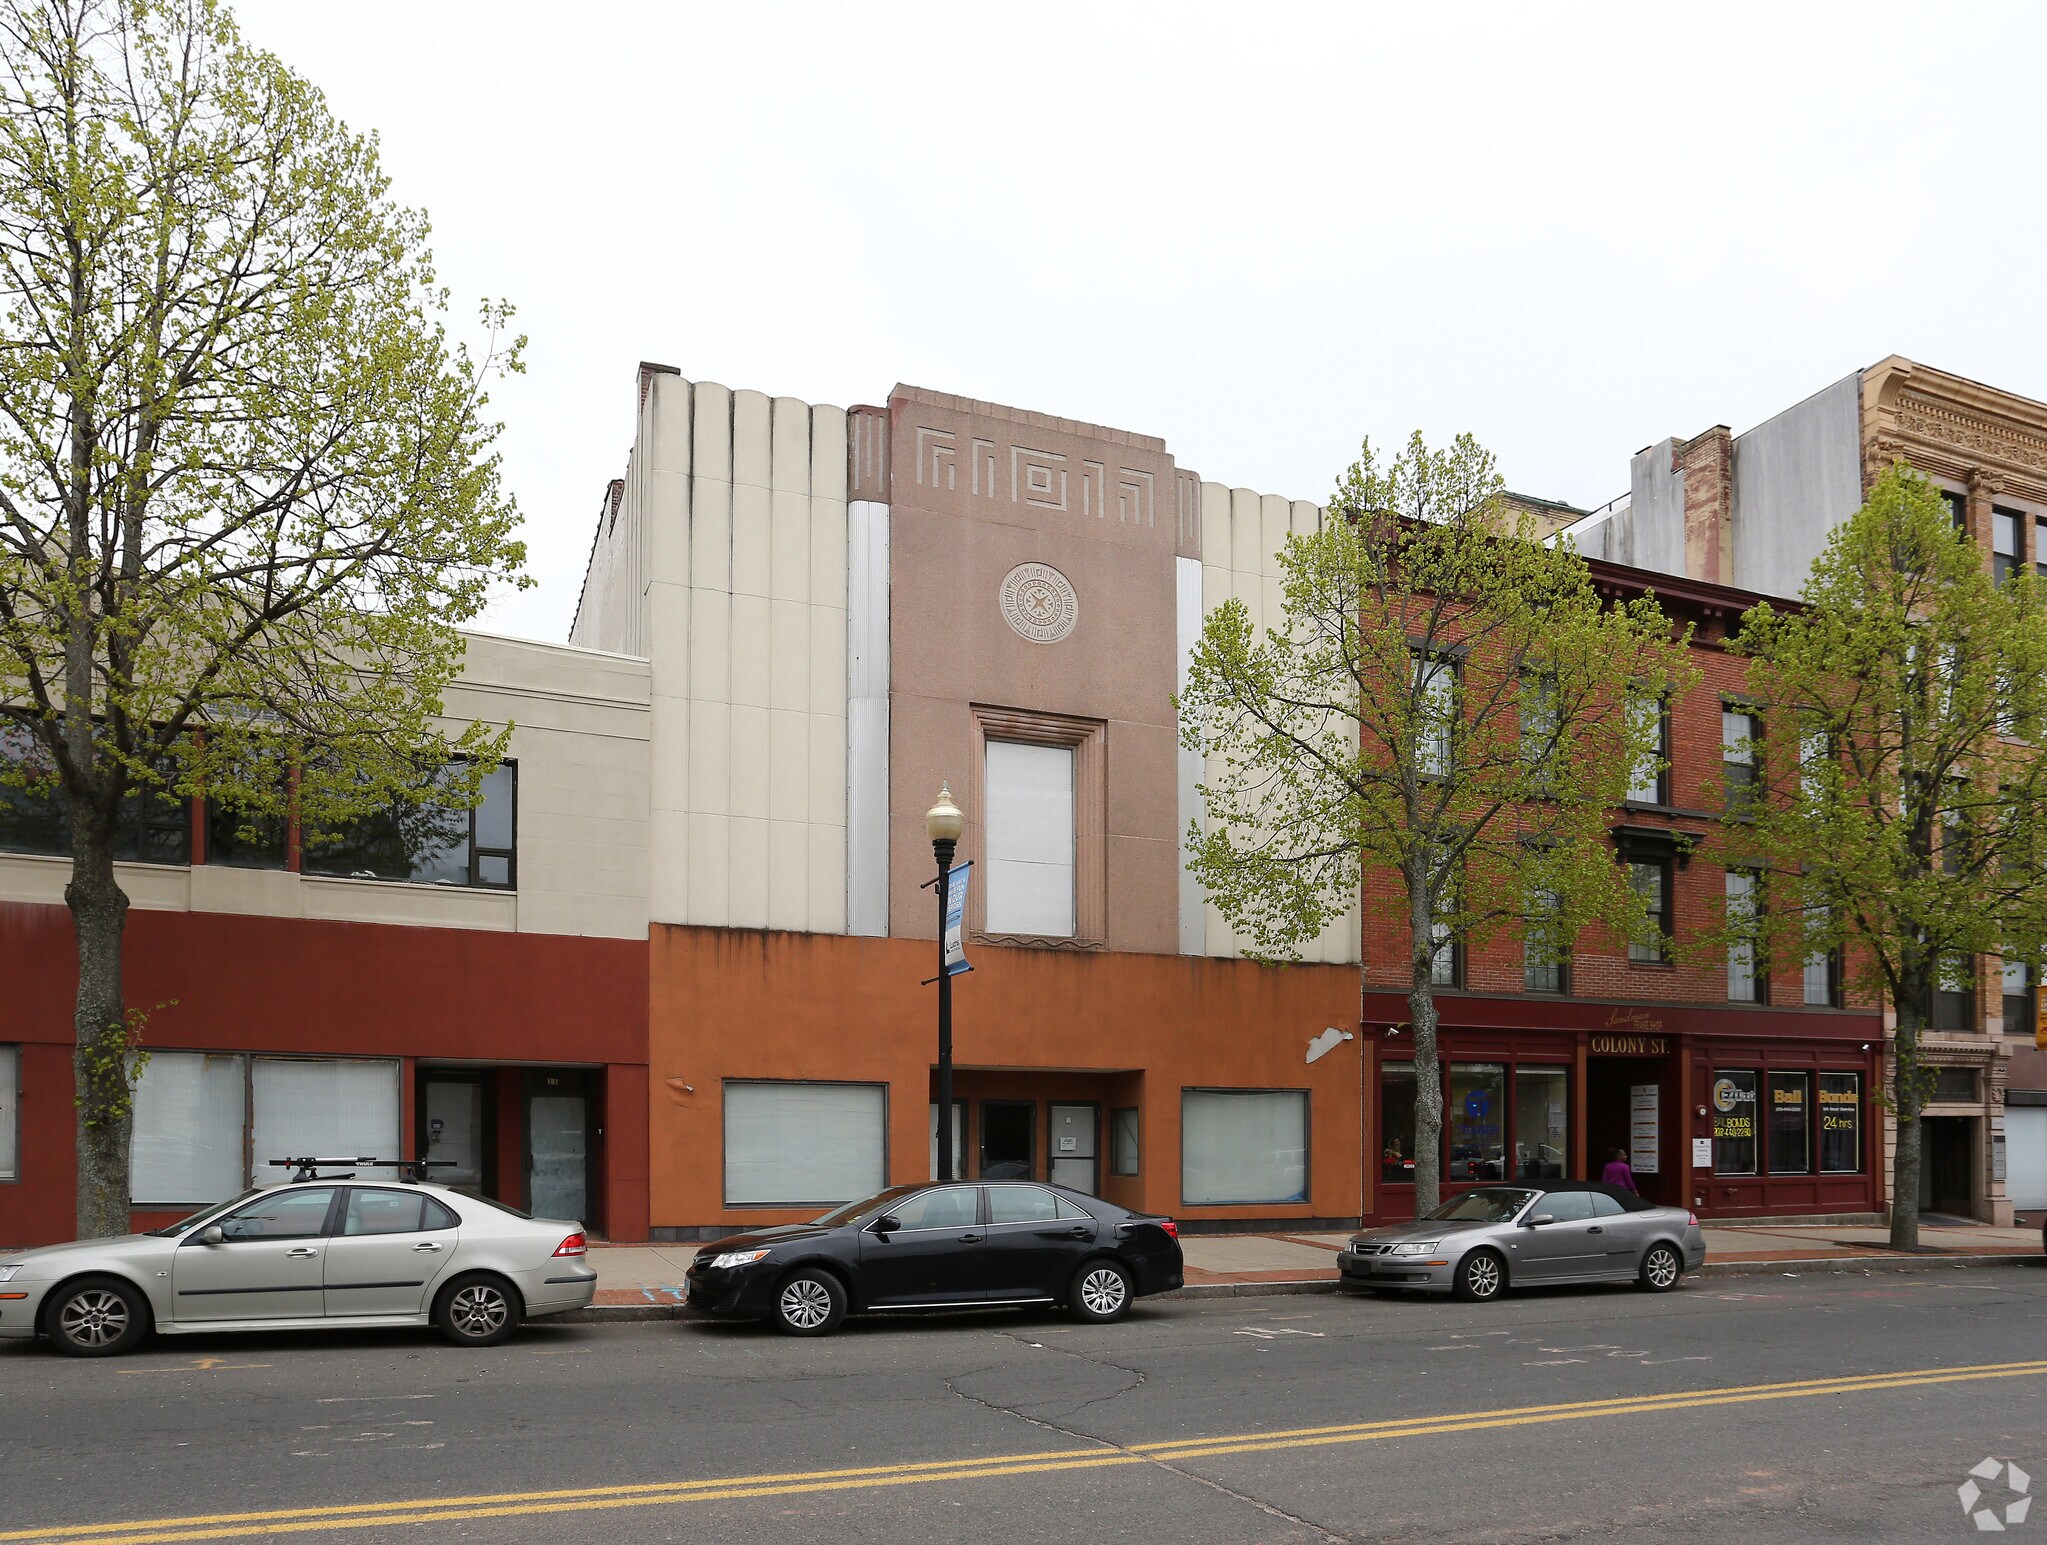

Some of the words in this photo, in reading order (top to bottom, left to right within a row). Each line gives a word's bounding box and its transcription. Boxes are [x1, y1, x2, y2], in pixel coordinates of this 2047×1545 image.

[1605, 1008, 1650, 1027] Sandman
[1592, 1036, 1646, 1053] COLONY
[1651, 1038, 1670, 1054] ST.
[1774, 1090, 1802, 1103] Bail
[1819, 1090, 1859, 1103] Bonds
[1824, 1115, 1837, 1130] 24
[1838, 1119, 1852, 1129] hrs
